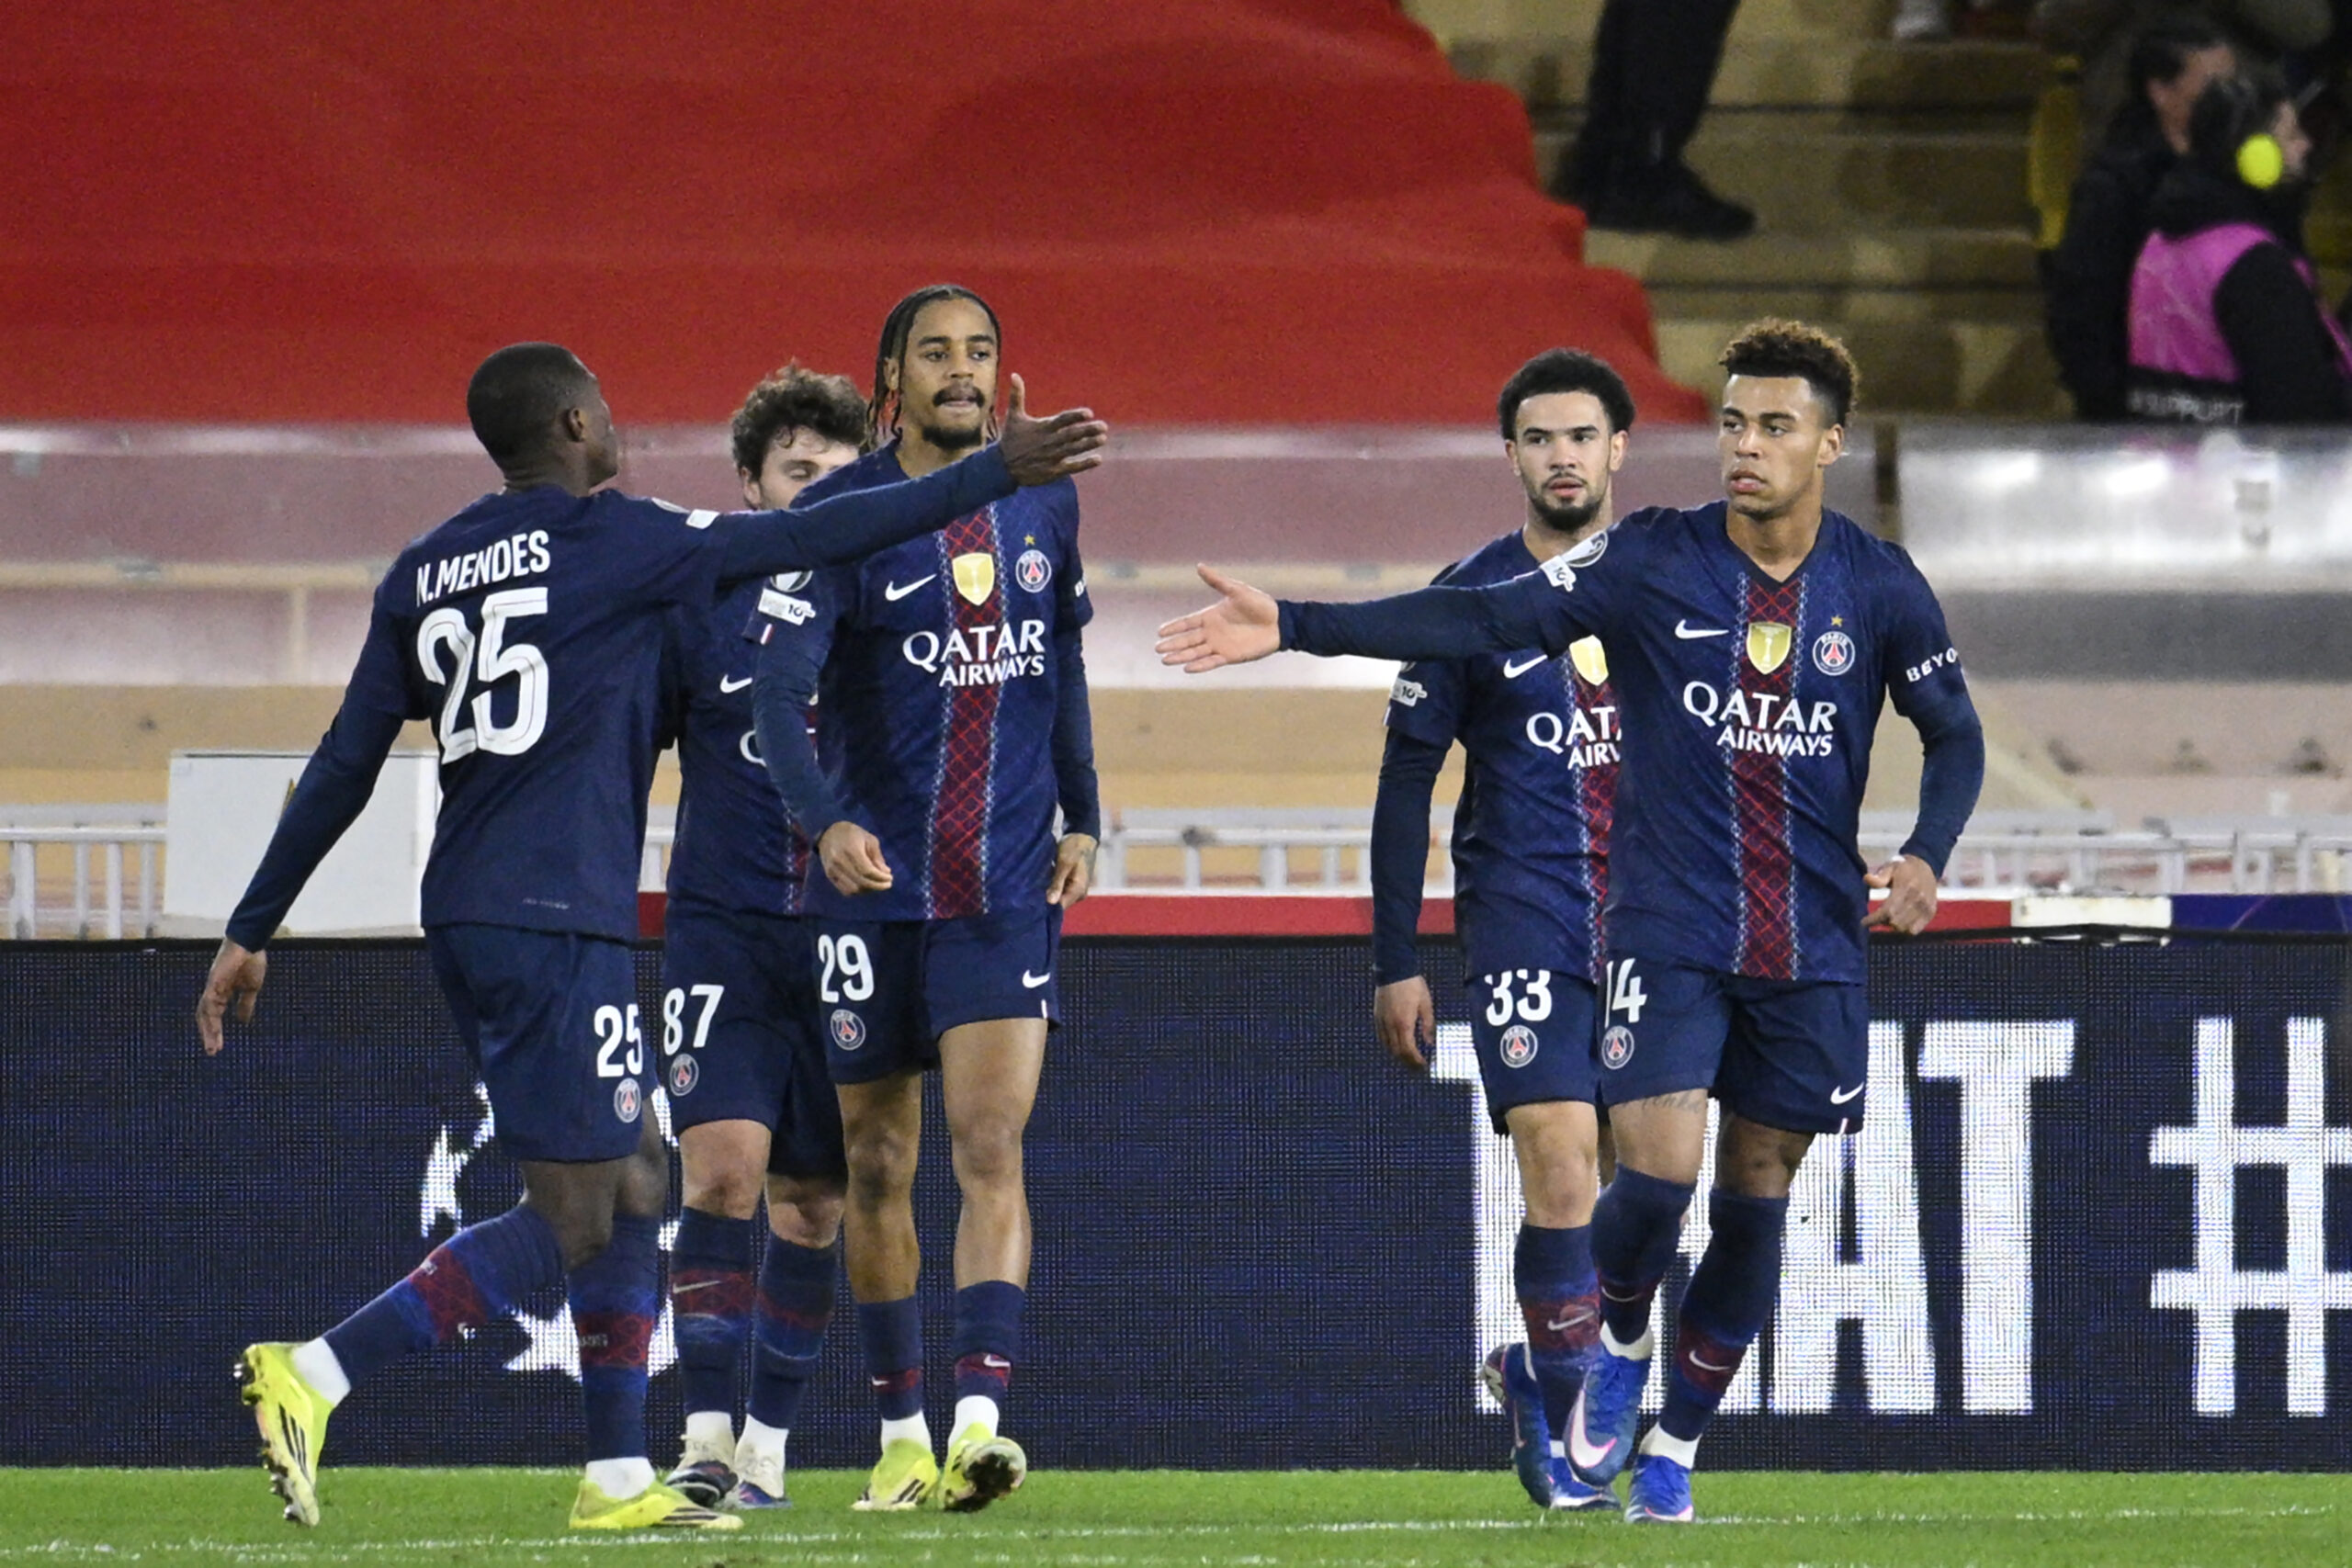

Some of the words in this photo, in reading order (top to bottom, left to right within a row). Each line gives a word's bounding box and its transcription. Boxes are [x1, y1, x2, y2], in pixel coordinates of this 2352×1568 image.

[415, 529, 551, 607] N.MENDES
[902, 619, 1046, 673] QATAR
[939, 654, 1045, 687] AIRWAYS
[1905, 647, 1959, 682] BEYO
[416, 586, 549, 765] 25
[1526, 705, 1623, 755] QAT
[1682, 681, 1838, 734] QATAR
[1716, 724, 1834, 757] AIRWAYS
[818, 934, 875, 1003] 29
[662, 984, 725, 1055] 87
[1485, 969, 1553, 1027] 33
[594, 1003, 643, 1078] 25
